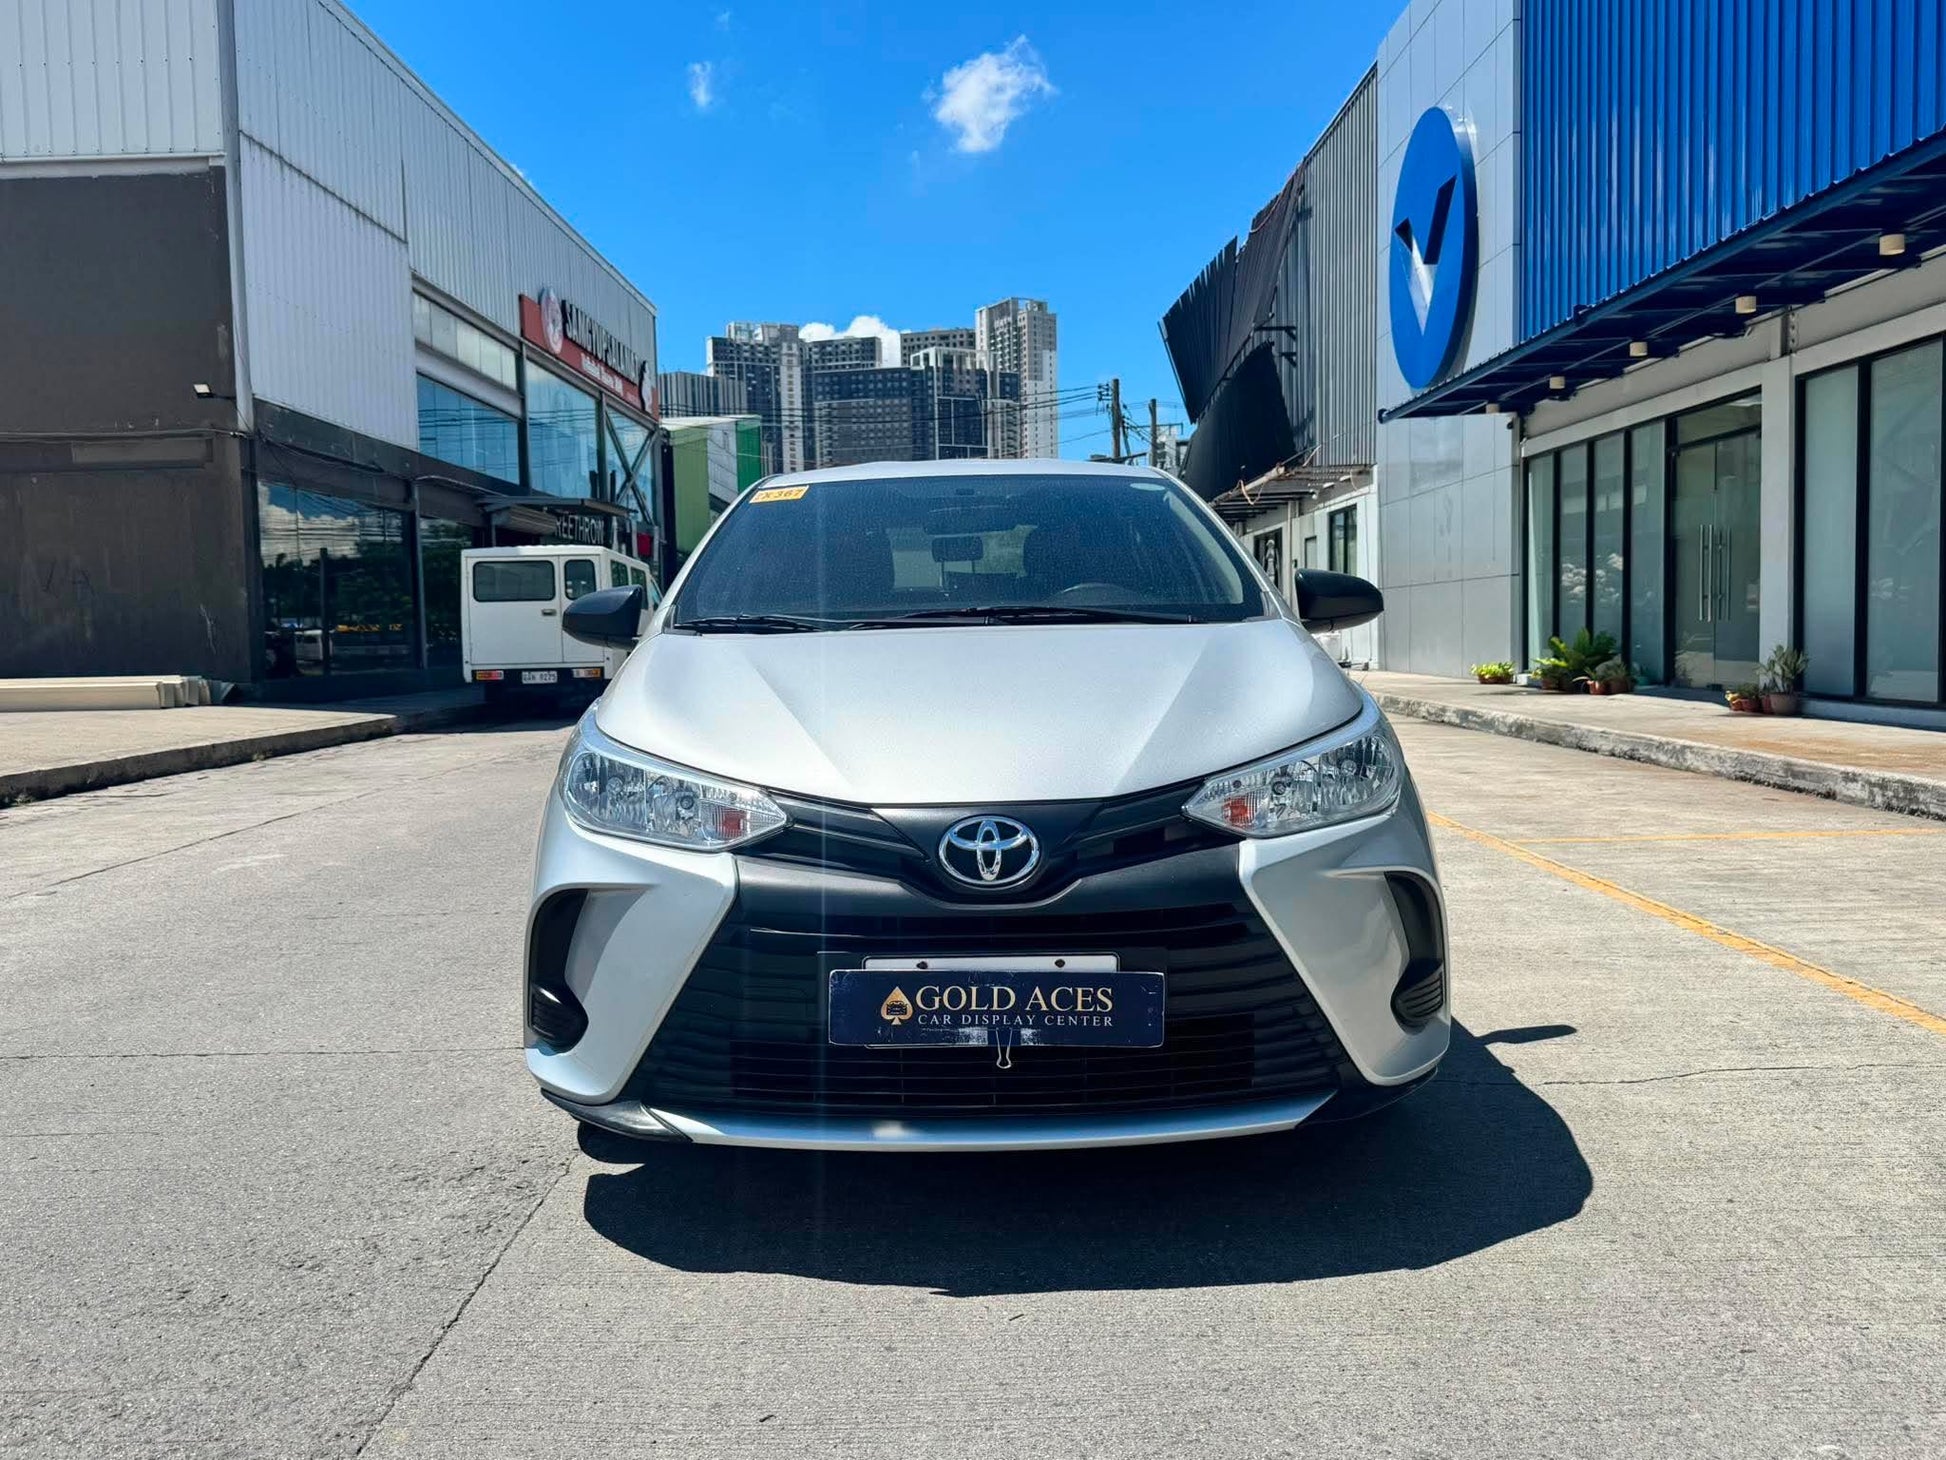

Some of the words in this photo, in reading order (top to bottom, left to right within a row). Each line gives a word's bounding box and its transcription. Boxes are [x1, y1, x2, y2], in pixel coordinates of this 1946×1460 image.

[555, 515, 605, 545] REETHROW
[915, 985, 1016, 1012] GOLD
[1026, 986, 1113, 1012] ACES
[917, 1014, 952, 1025] CAR
[961, 1014, 1036, 1025] DISPLAY
[1044, 1014, 1113, 1027] CENTER
